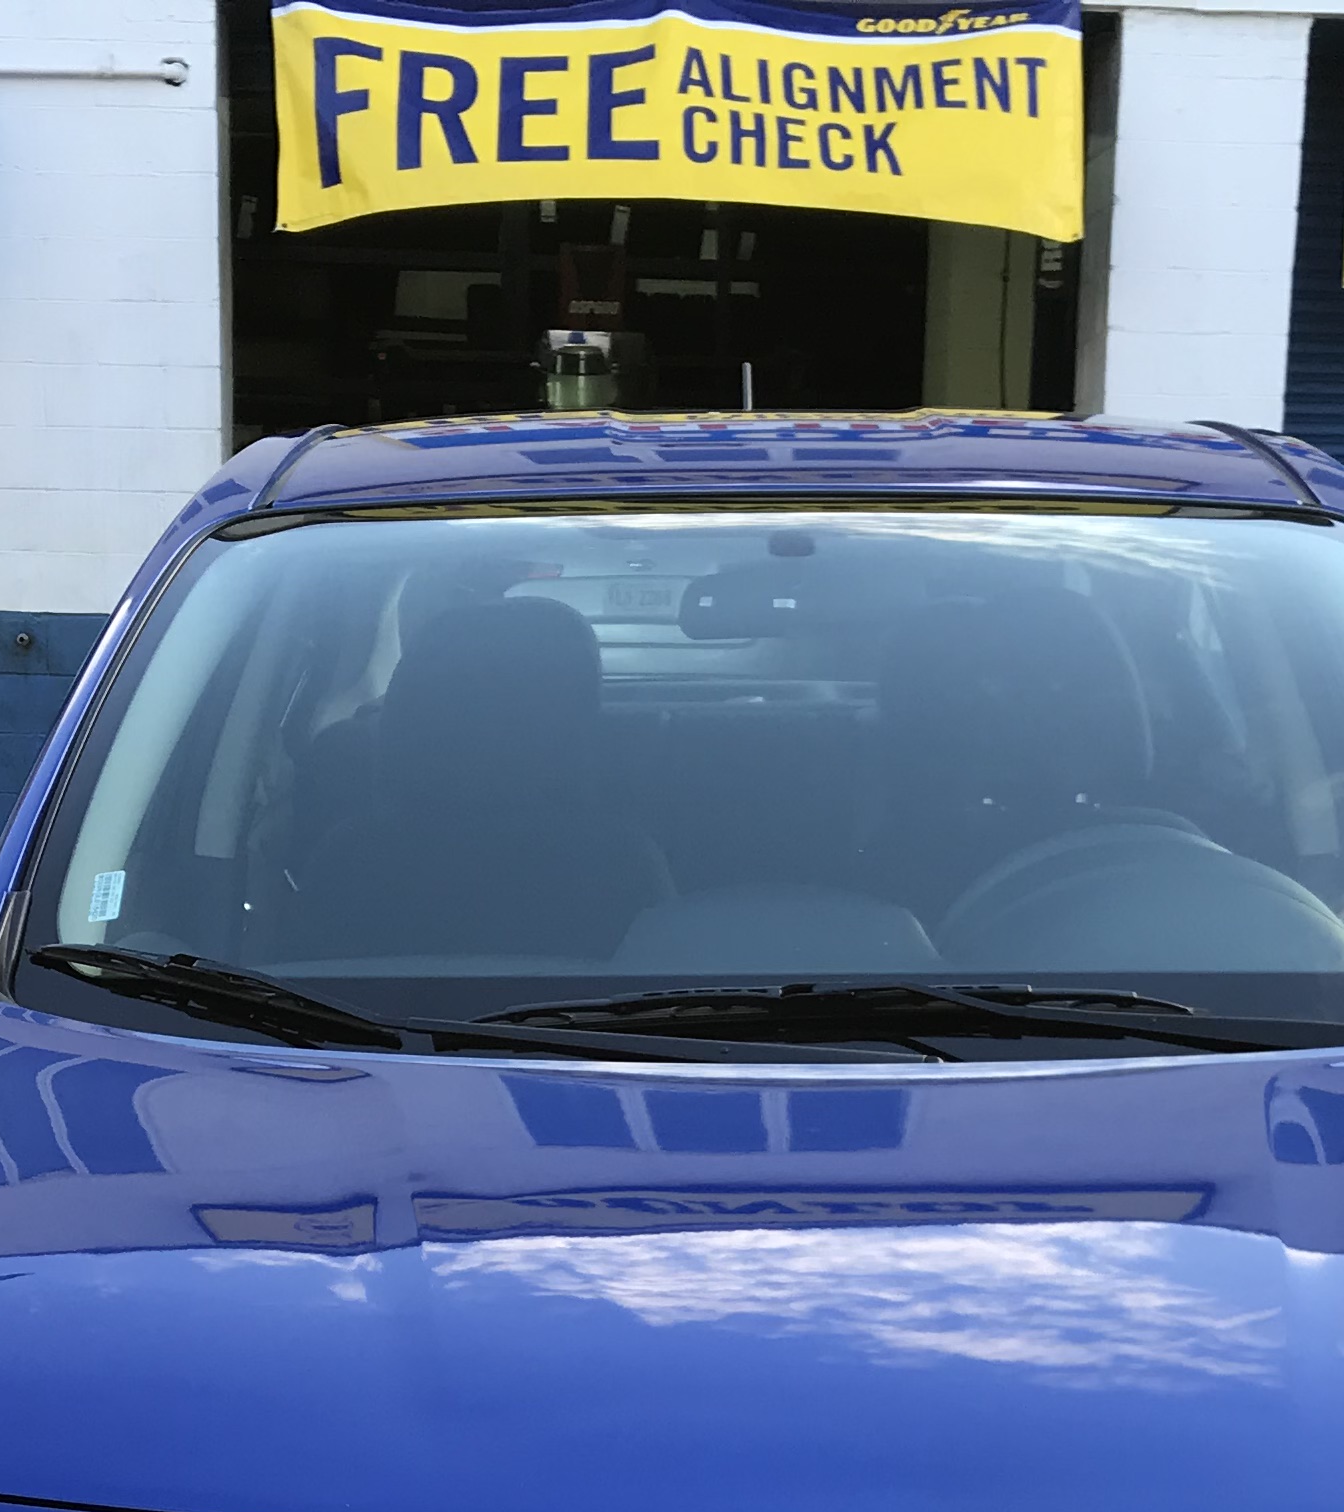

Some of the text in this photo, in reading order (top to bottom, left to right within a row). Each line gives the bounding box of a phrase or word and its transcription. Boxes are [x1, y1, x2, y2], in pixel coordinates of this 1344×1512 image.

[855, 9, 1031, 35] GOODYEAR
[313, 36, 1047, 188] FREE ALIGNMENT
[682, 107, 902, 175] CHECK
